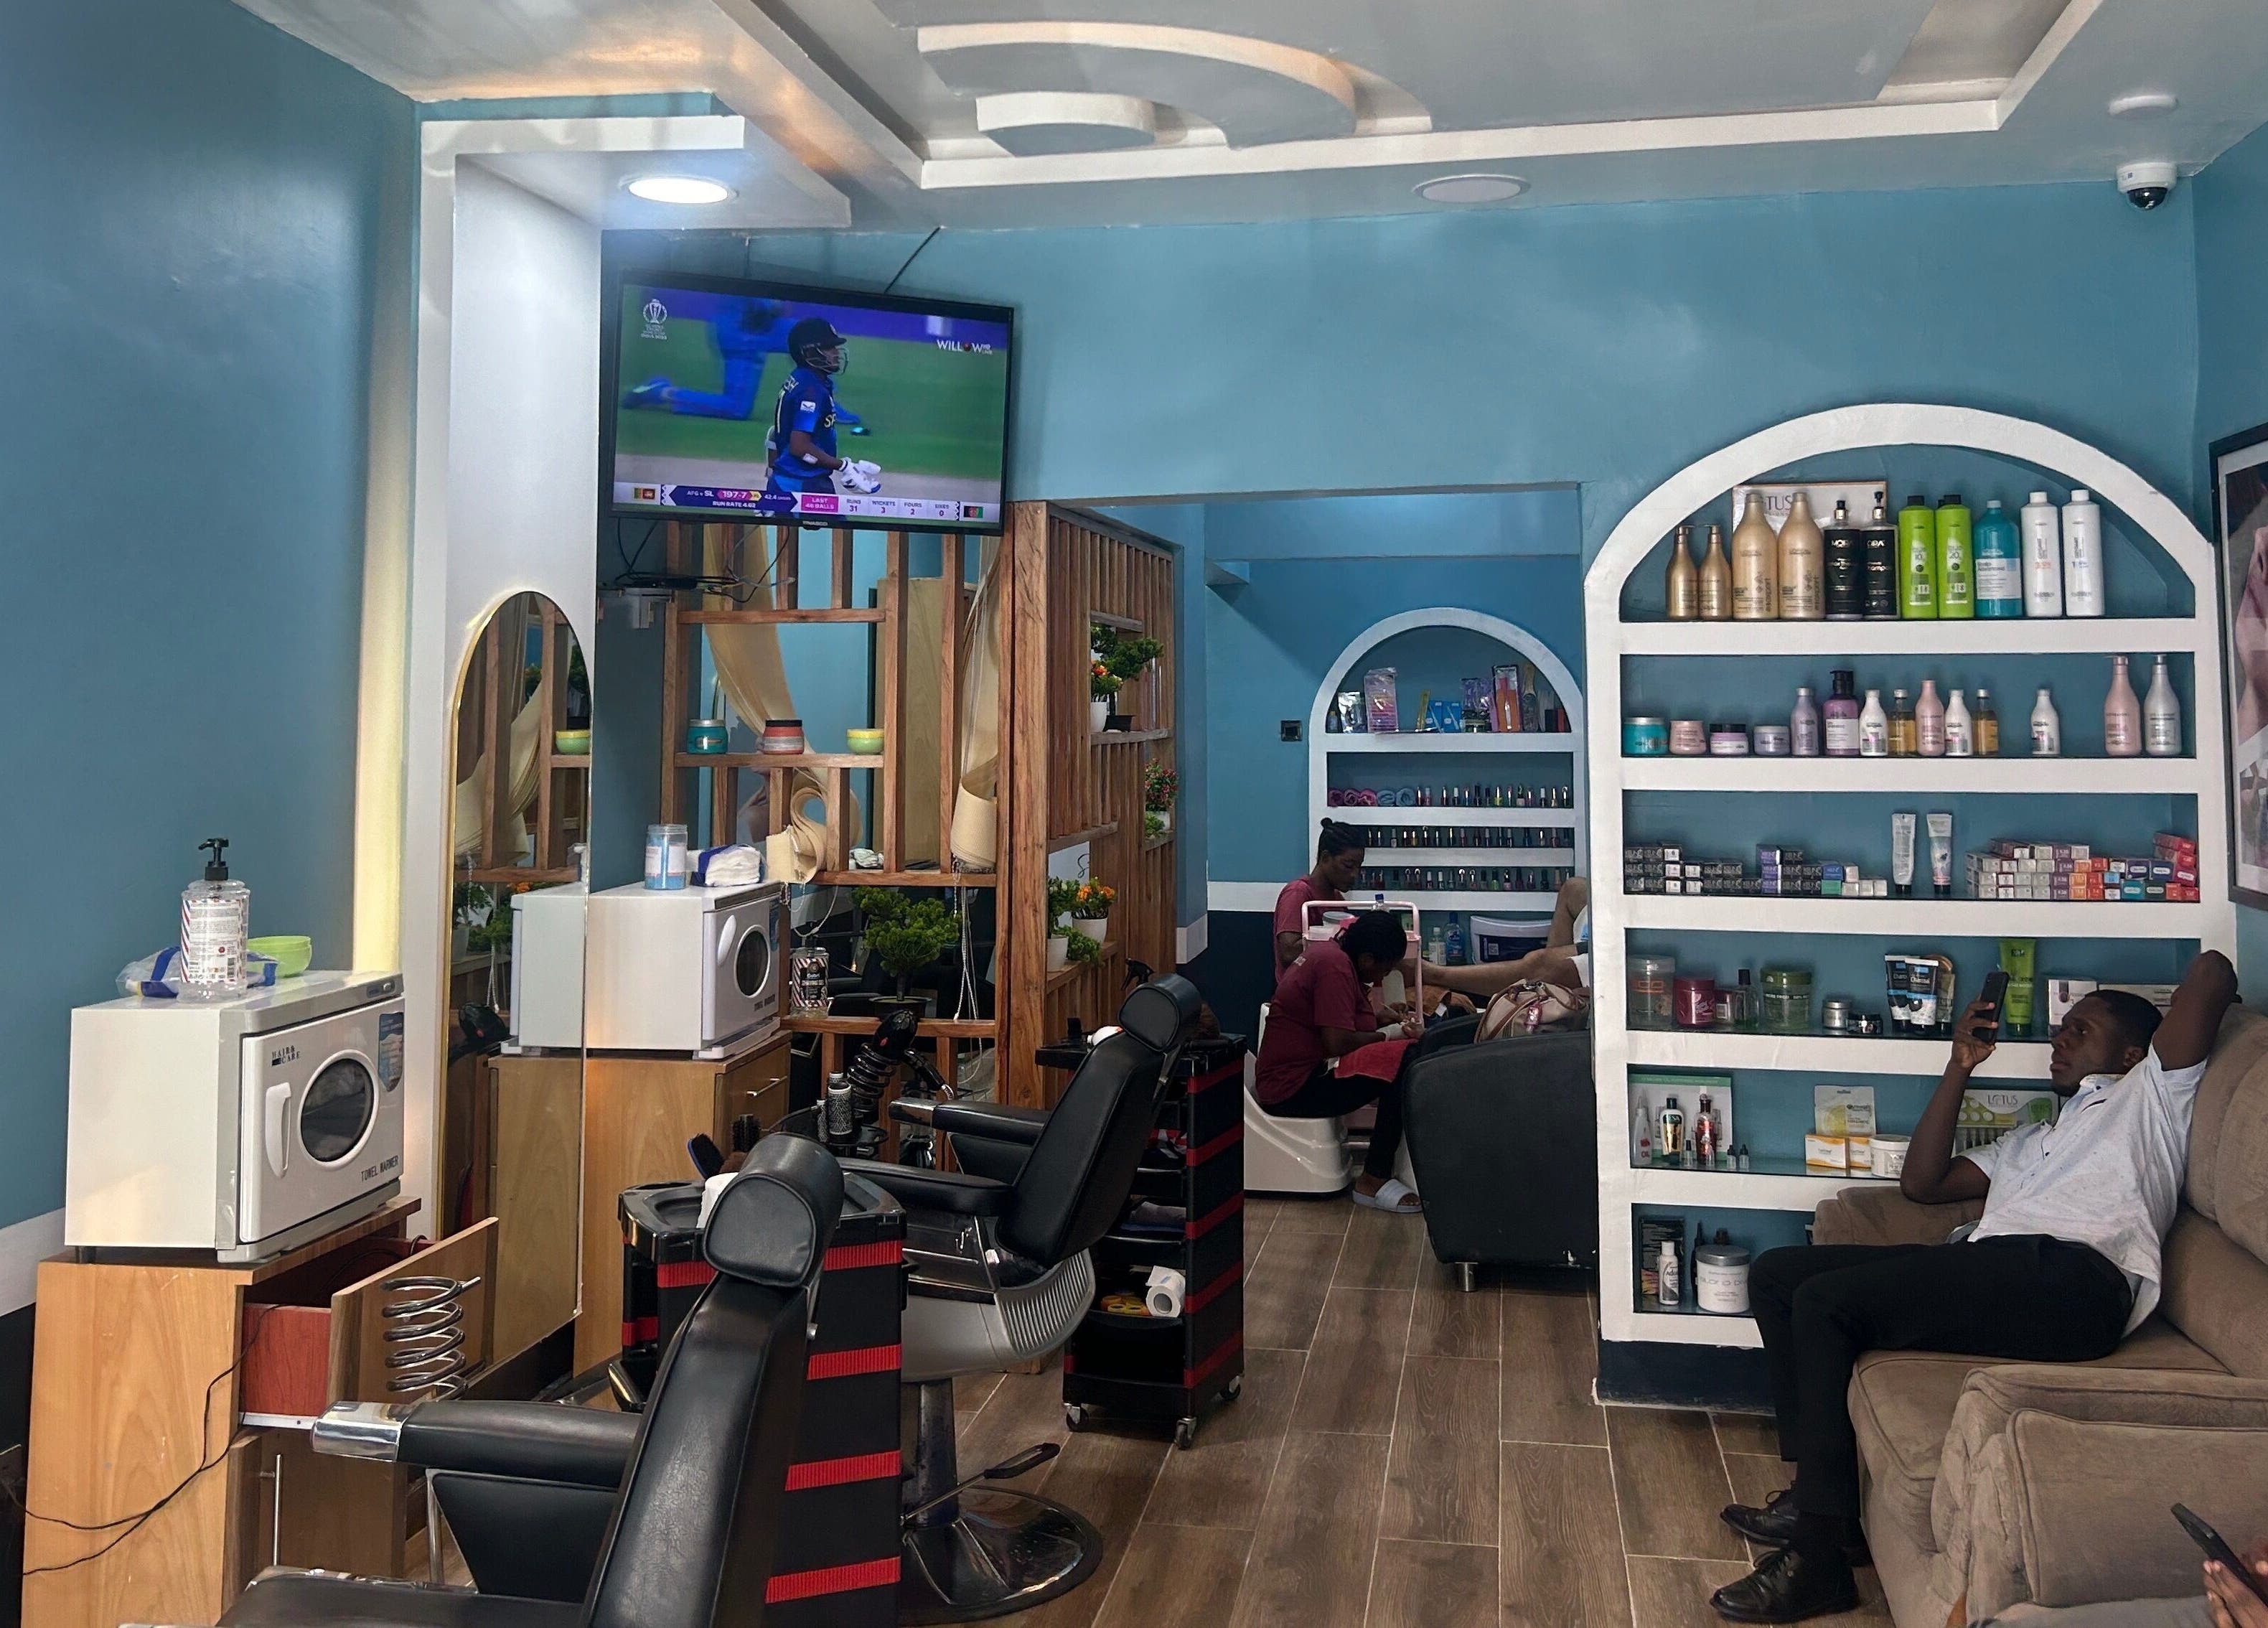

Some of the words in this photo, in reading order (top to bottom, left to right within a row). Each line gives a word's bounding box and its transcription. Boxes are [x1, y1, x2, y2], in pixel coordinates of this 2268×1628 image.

[722, 490, 747, 499] 197-7
[281, 1050, 300, 1064] CARE
[1987, 1094, 2018, 1105] LOTUS
[361, 1165, 378, 1183] TOWEL
[380, 1155, 398, 1173] WARMER
